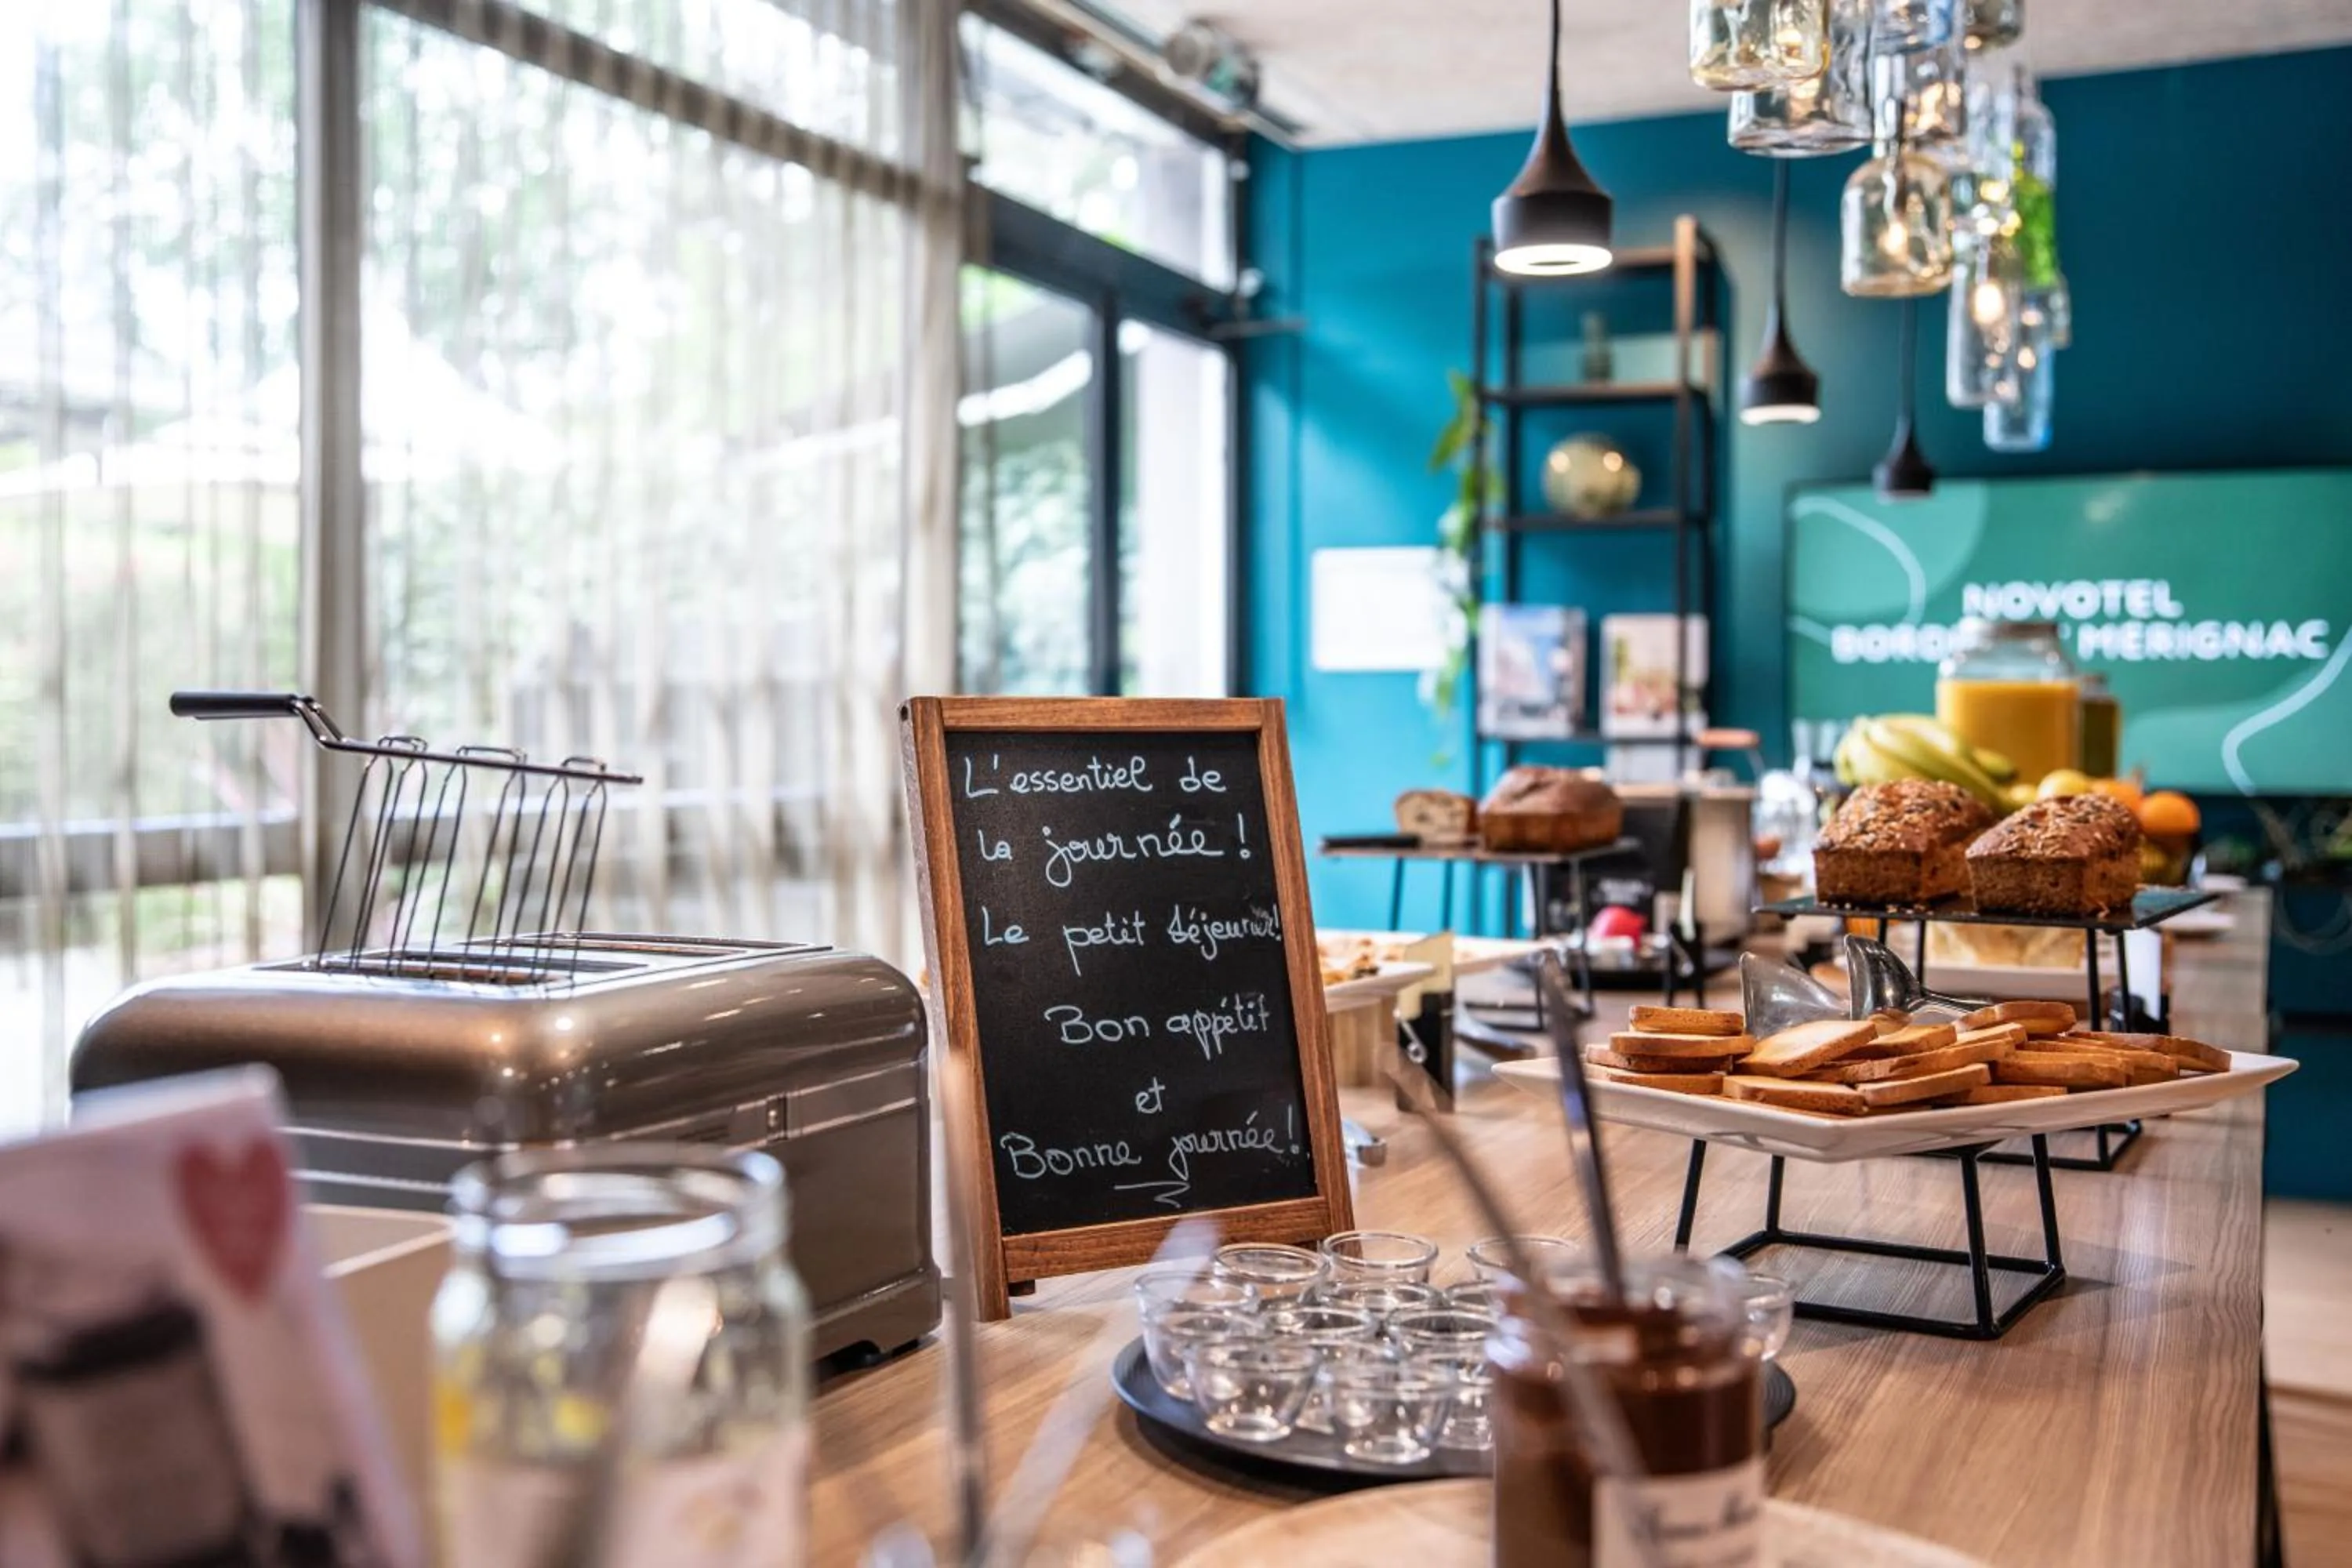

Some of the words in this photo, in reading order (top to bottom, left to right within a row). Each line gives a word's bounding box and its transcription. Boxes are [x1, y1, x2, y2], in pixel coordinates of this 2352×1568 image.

[1962, 579, 2184, 619] NOVOTEL
[1831, 623, 2071, 664] BORD
[2078, 619, 2329, 661] MERIGNAC
[964, 753, 1153, 798] L'essentiel
[1179, 756, 1227, 792] de
[981, 906, 1030, 945] Le
[1062, 910, 1146, 976] petit
[1044, 1005, 1150, 1044] Bon
[1166, 993, 1270, 1060] appétit
[1135, 1076, 1166, 1113] et
[1000, 1131, 1142, 1178] Bonne
